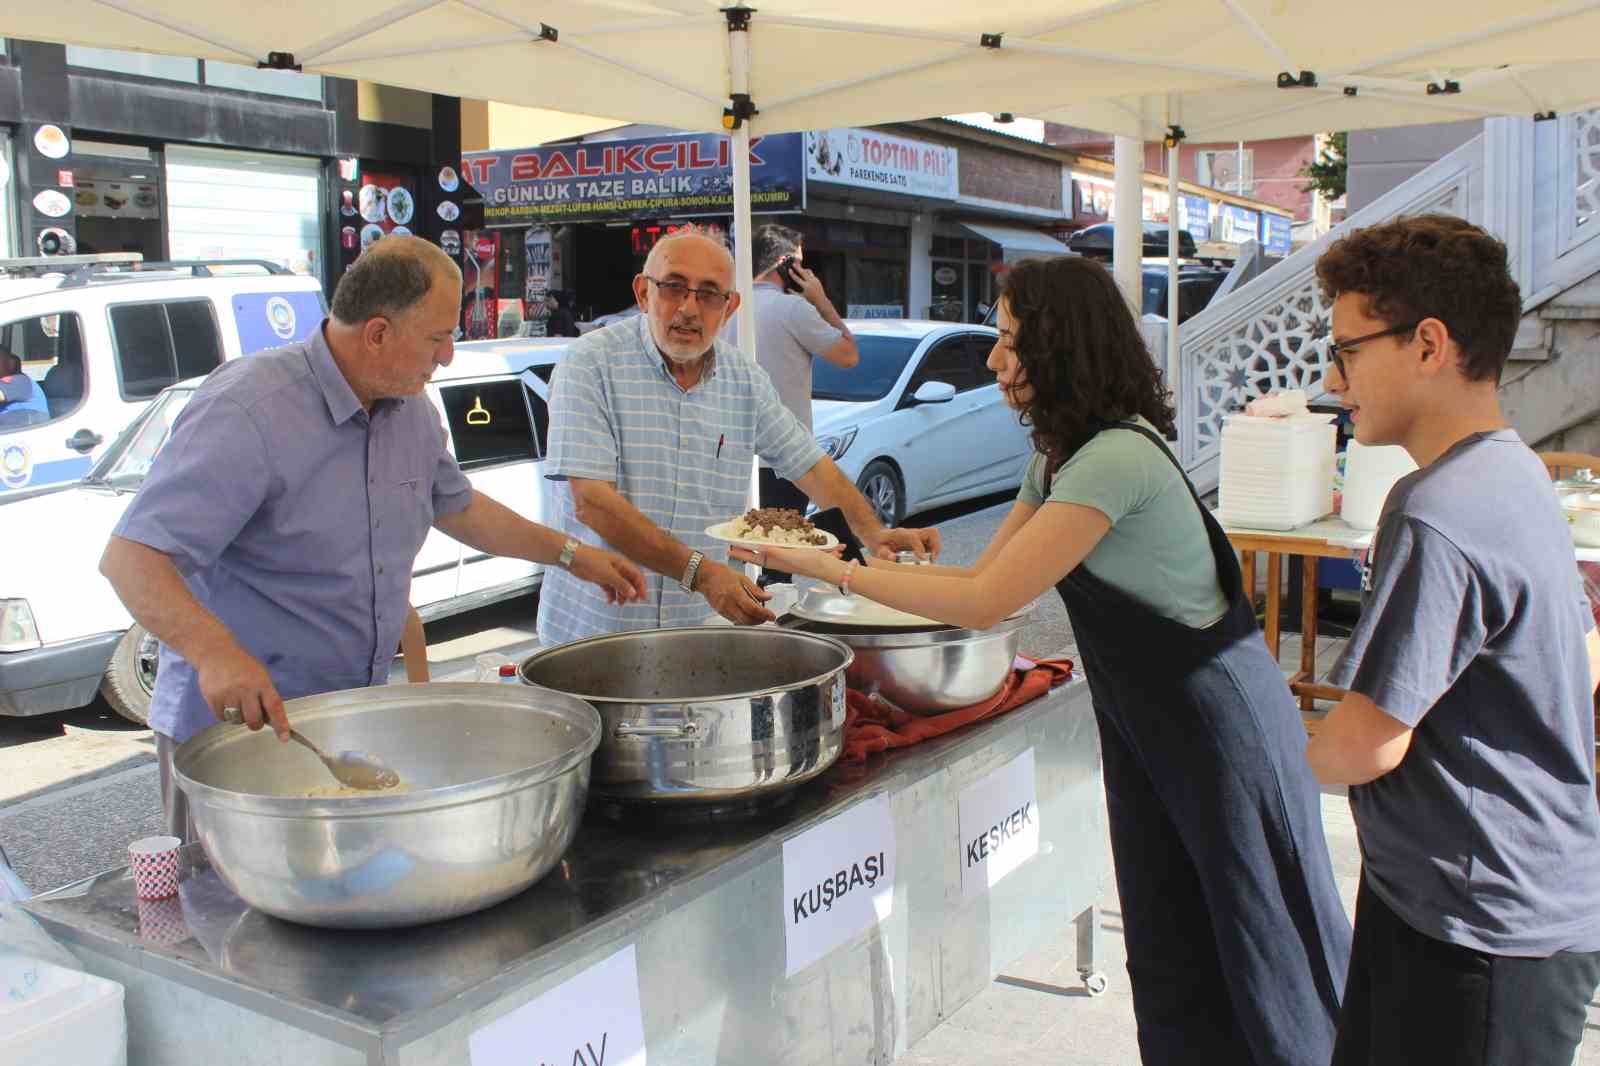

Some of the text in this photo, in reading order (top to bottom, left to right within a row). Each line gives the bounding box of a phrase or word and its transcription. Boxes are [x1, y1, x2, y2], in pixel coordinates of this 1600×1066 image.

[862, 137, 919, 171] TOPTAN
[494, 175, 693, 204] GÜNLÜK TAZE BALIK
[967, 801, 1032, 869] KESKEK
[793, 851, 885, 925] KUŞBAŞI
